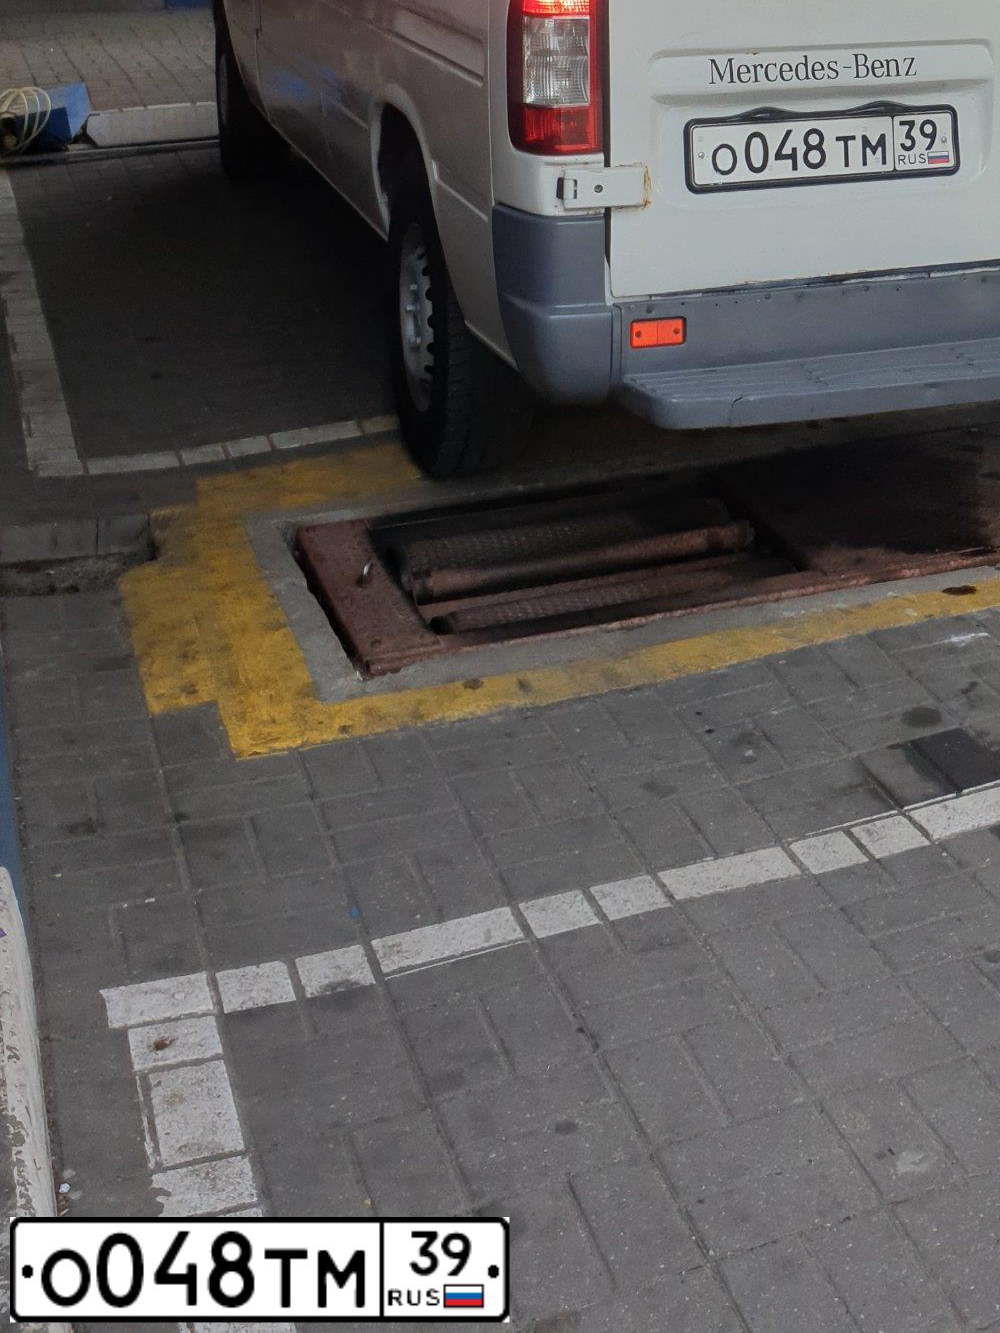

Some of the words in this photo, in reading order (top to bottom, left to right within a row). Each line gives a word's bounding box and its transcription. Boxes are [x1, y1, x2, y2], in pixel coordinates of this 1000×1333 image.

[708, 53, 917, 85] Mercedes-Benz
[899, 119, 938, 151] 39
[897, 153, 927, 165] RUS
